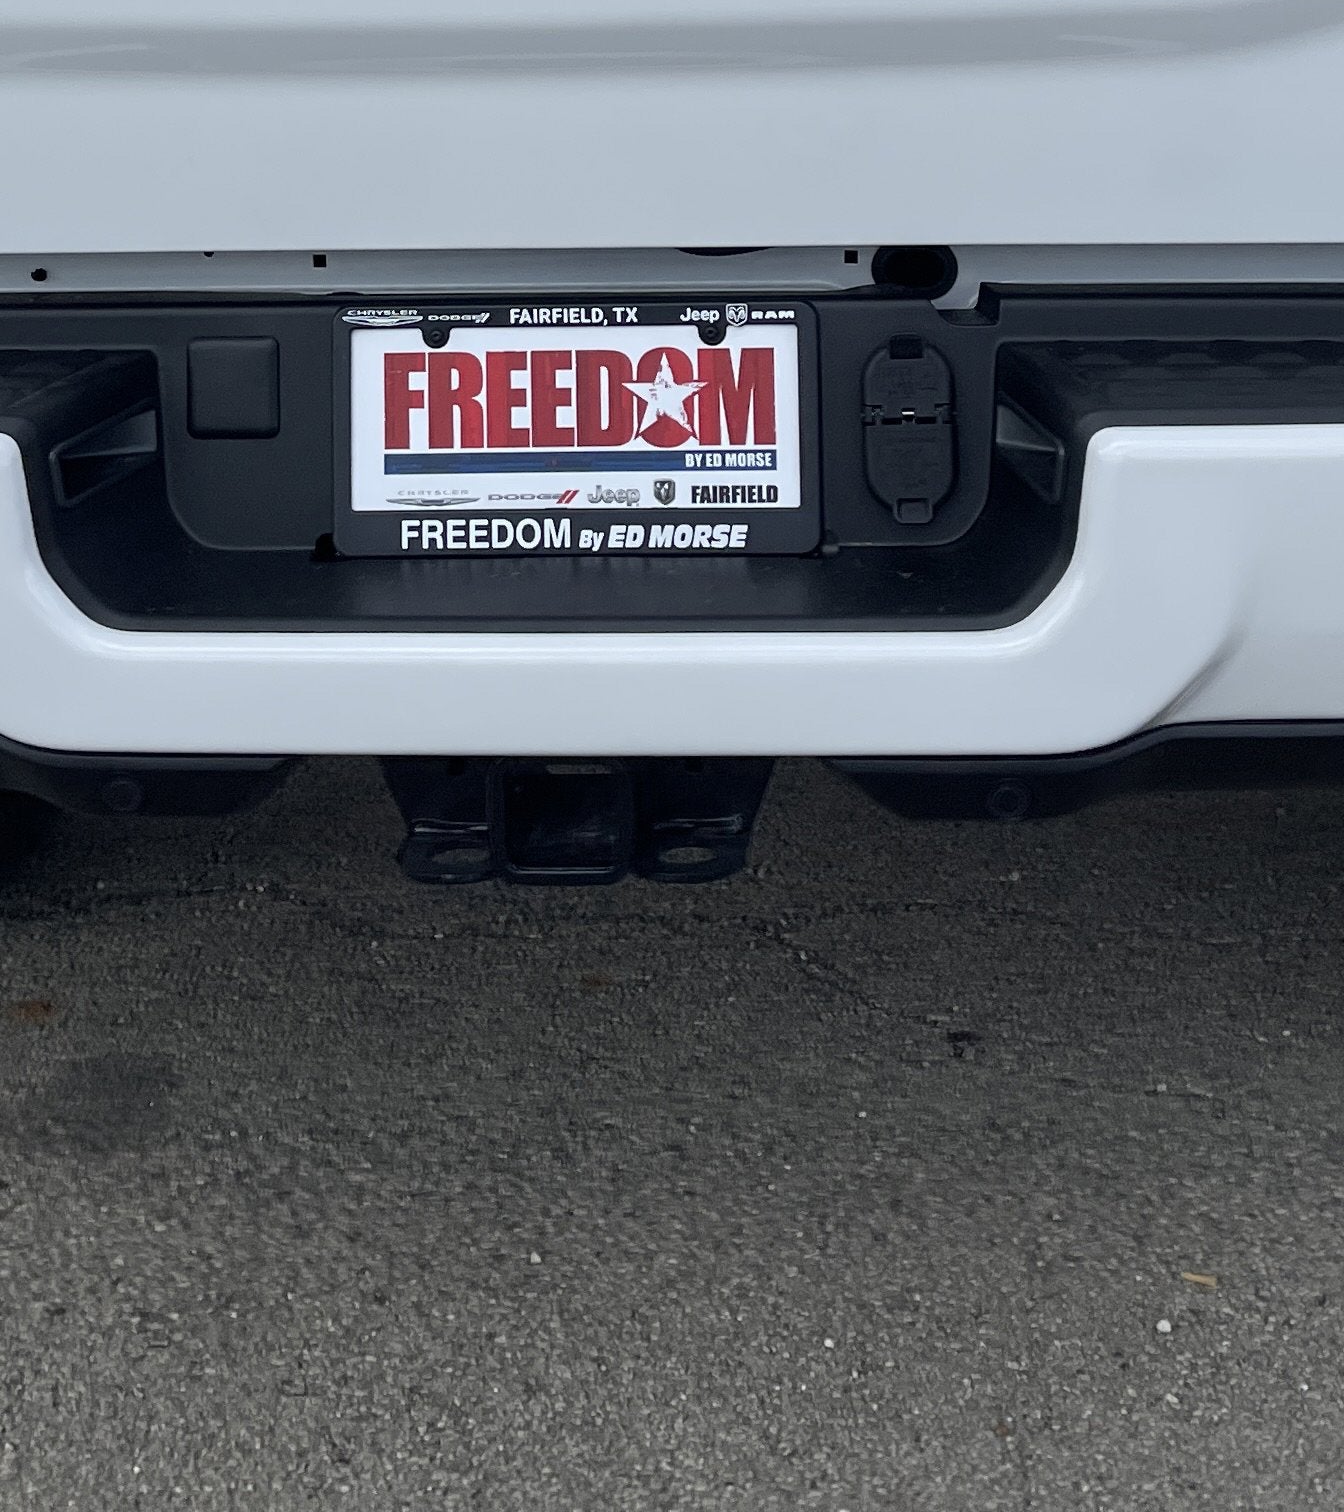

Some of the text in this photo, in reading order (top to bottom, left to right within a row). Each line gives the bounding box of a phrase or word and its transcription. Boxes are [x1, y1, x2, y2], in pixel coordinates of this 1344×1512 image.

[510, 307, 607, 327] FAIRFIELD,
[612, 307, 639, 323] TX
[680, 307, 720, 323] Jeep
[751, 310, 795, 319] RAM
[383, 347, 777, 449] FREEDOM
[685, 452, 772, 467] BY ED MORSE
[488, 493, 560, 501] DODGE
[587, 484, 640, 506] Jeep
[691, 484, 778, 504] FAIRFIELD
[401, 518, 749, 552] FREEDOM By ED MORSE
